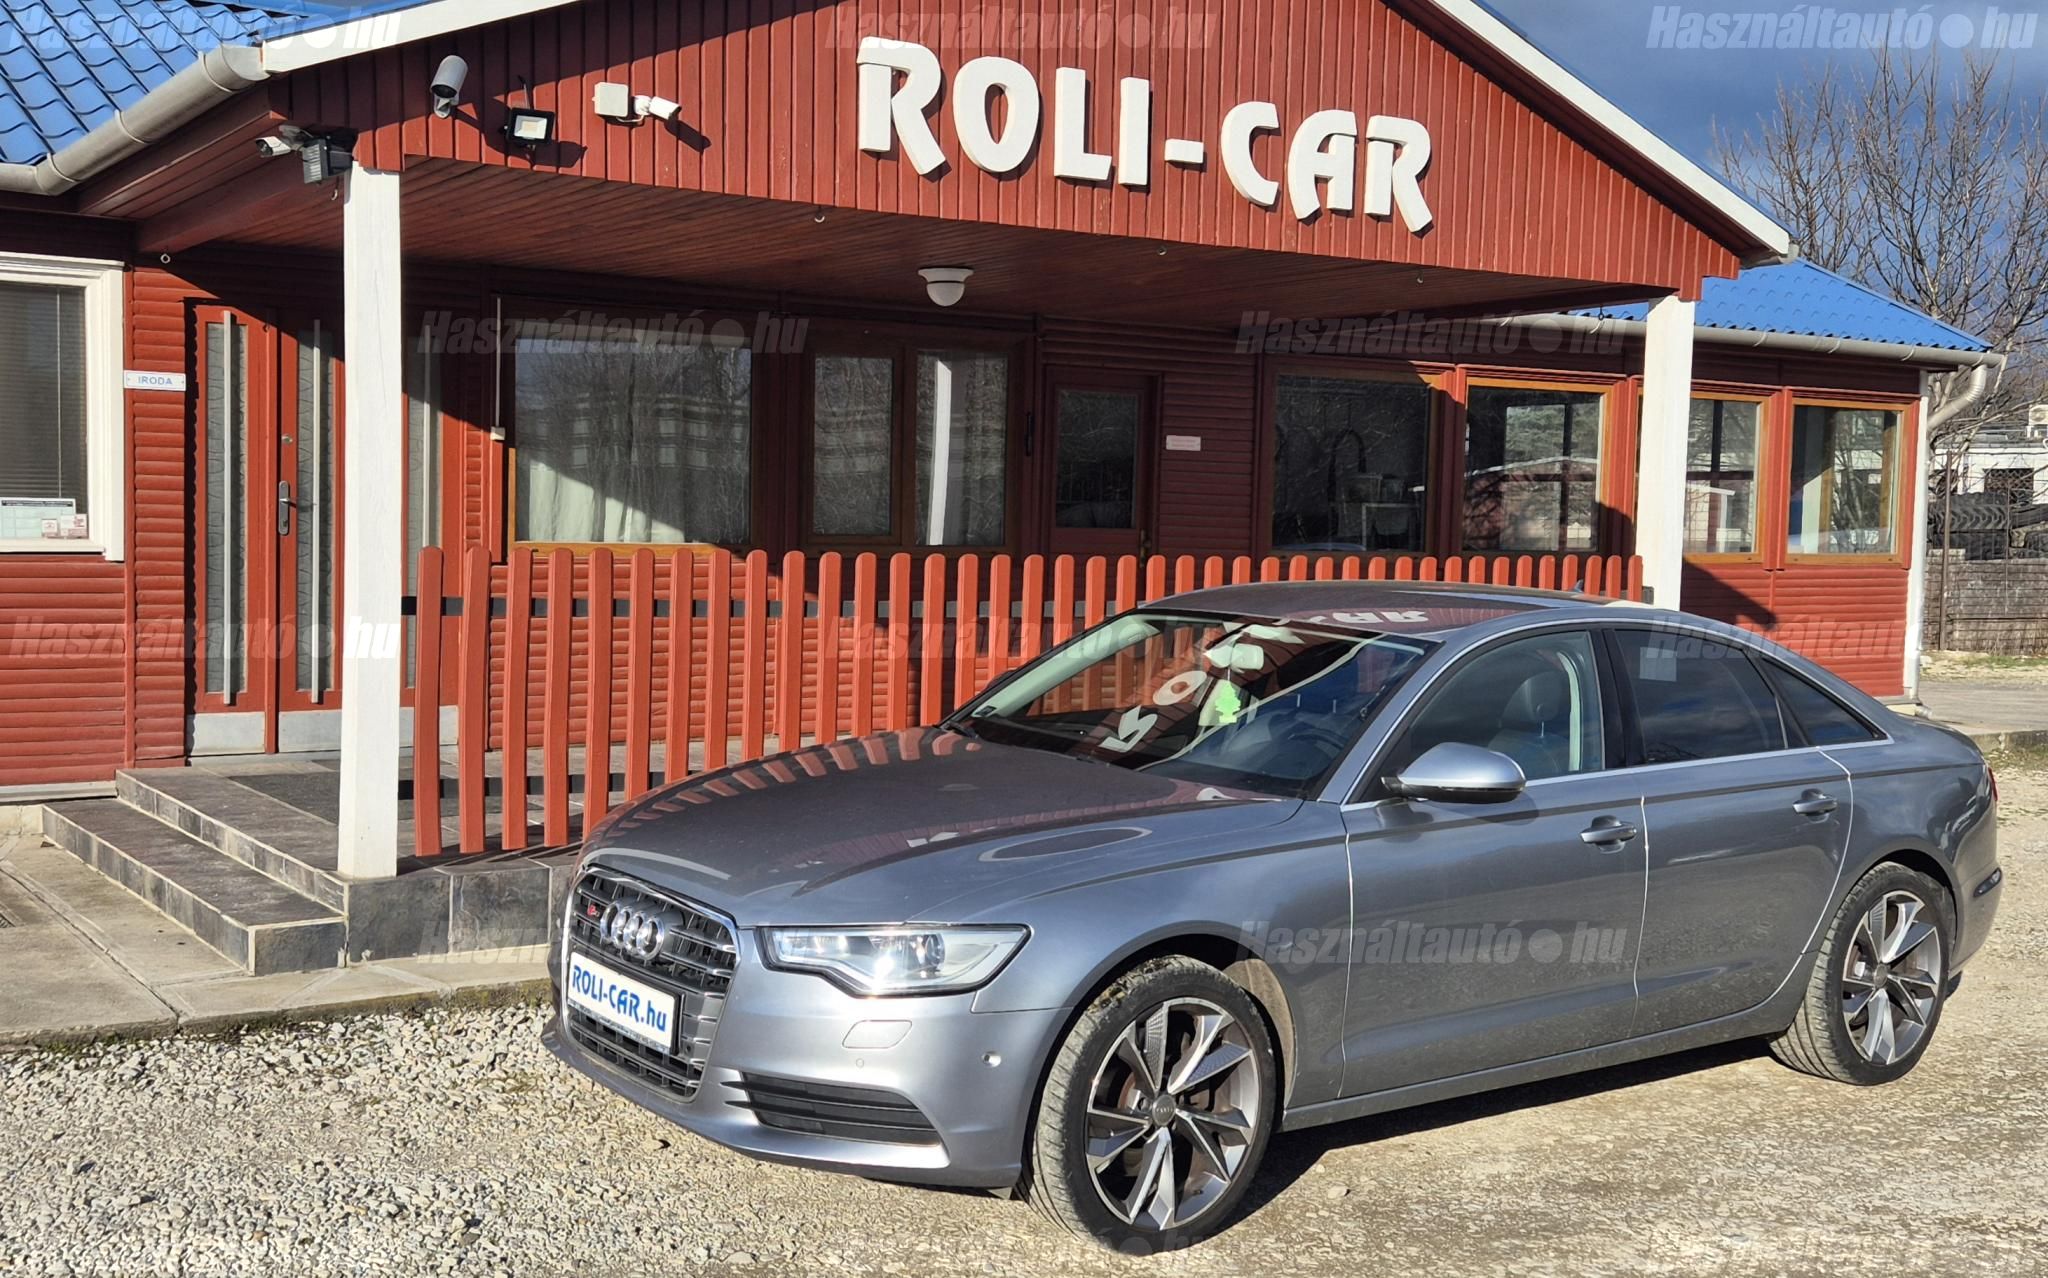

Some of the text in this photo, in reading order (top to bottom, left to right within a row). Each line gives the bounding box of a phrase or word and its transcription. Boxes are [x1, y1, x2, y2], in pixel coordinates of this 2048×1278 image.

[856, 36, 1432, 232] ROLI-CAR
[138, 375, 173, 385] IRODA
[572, 965, 667, 1032] ROLI-CAR.hu
